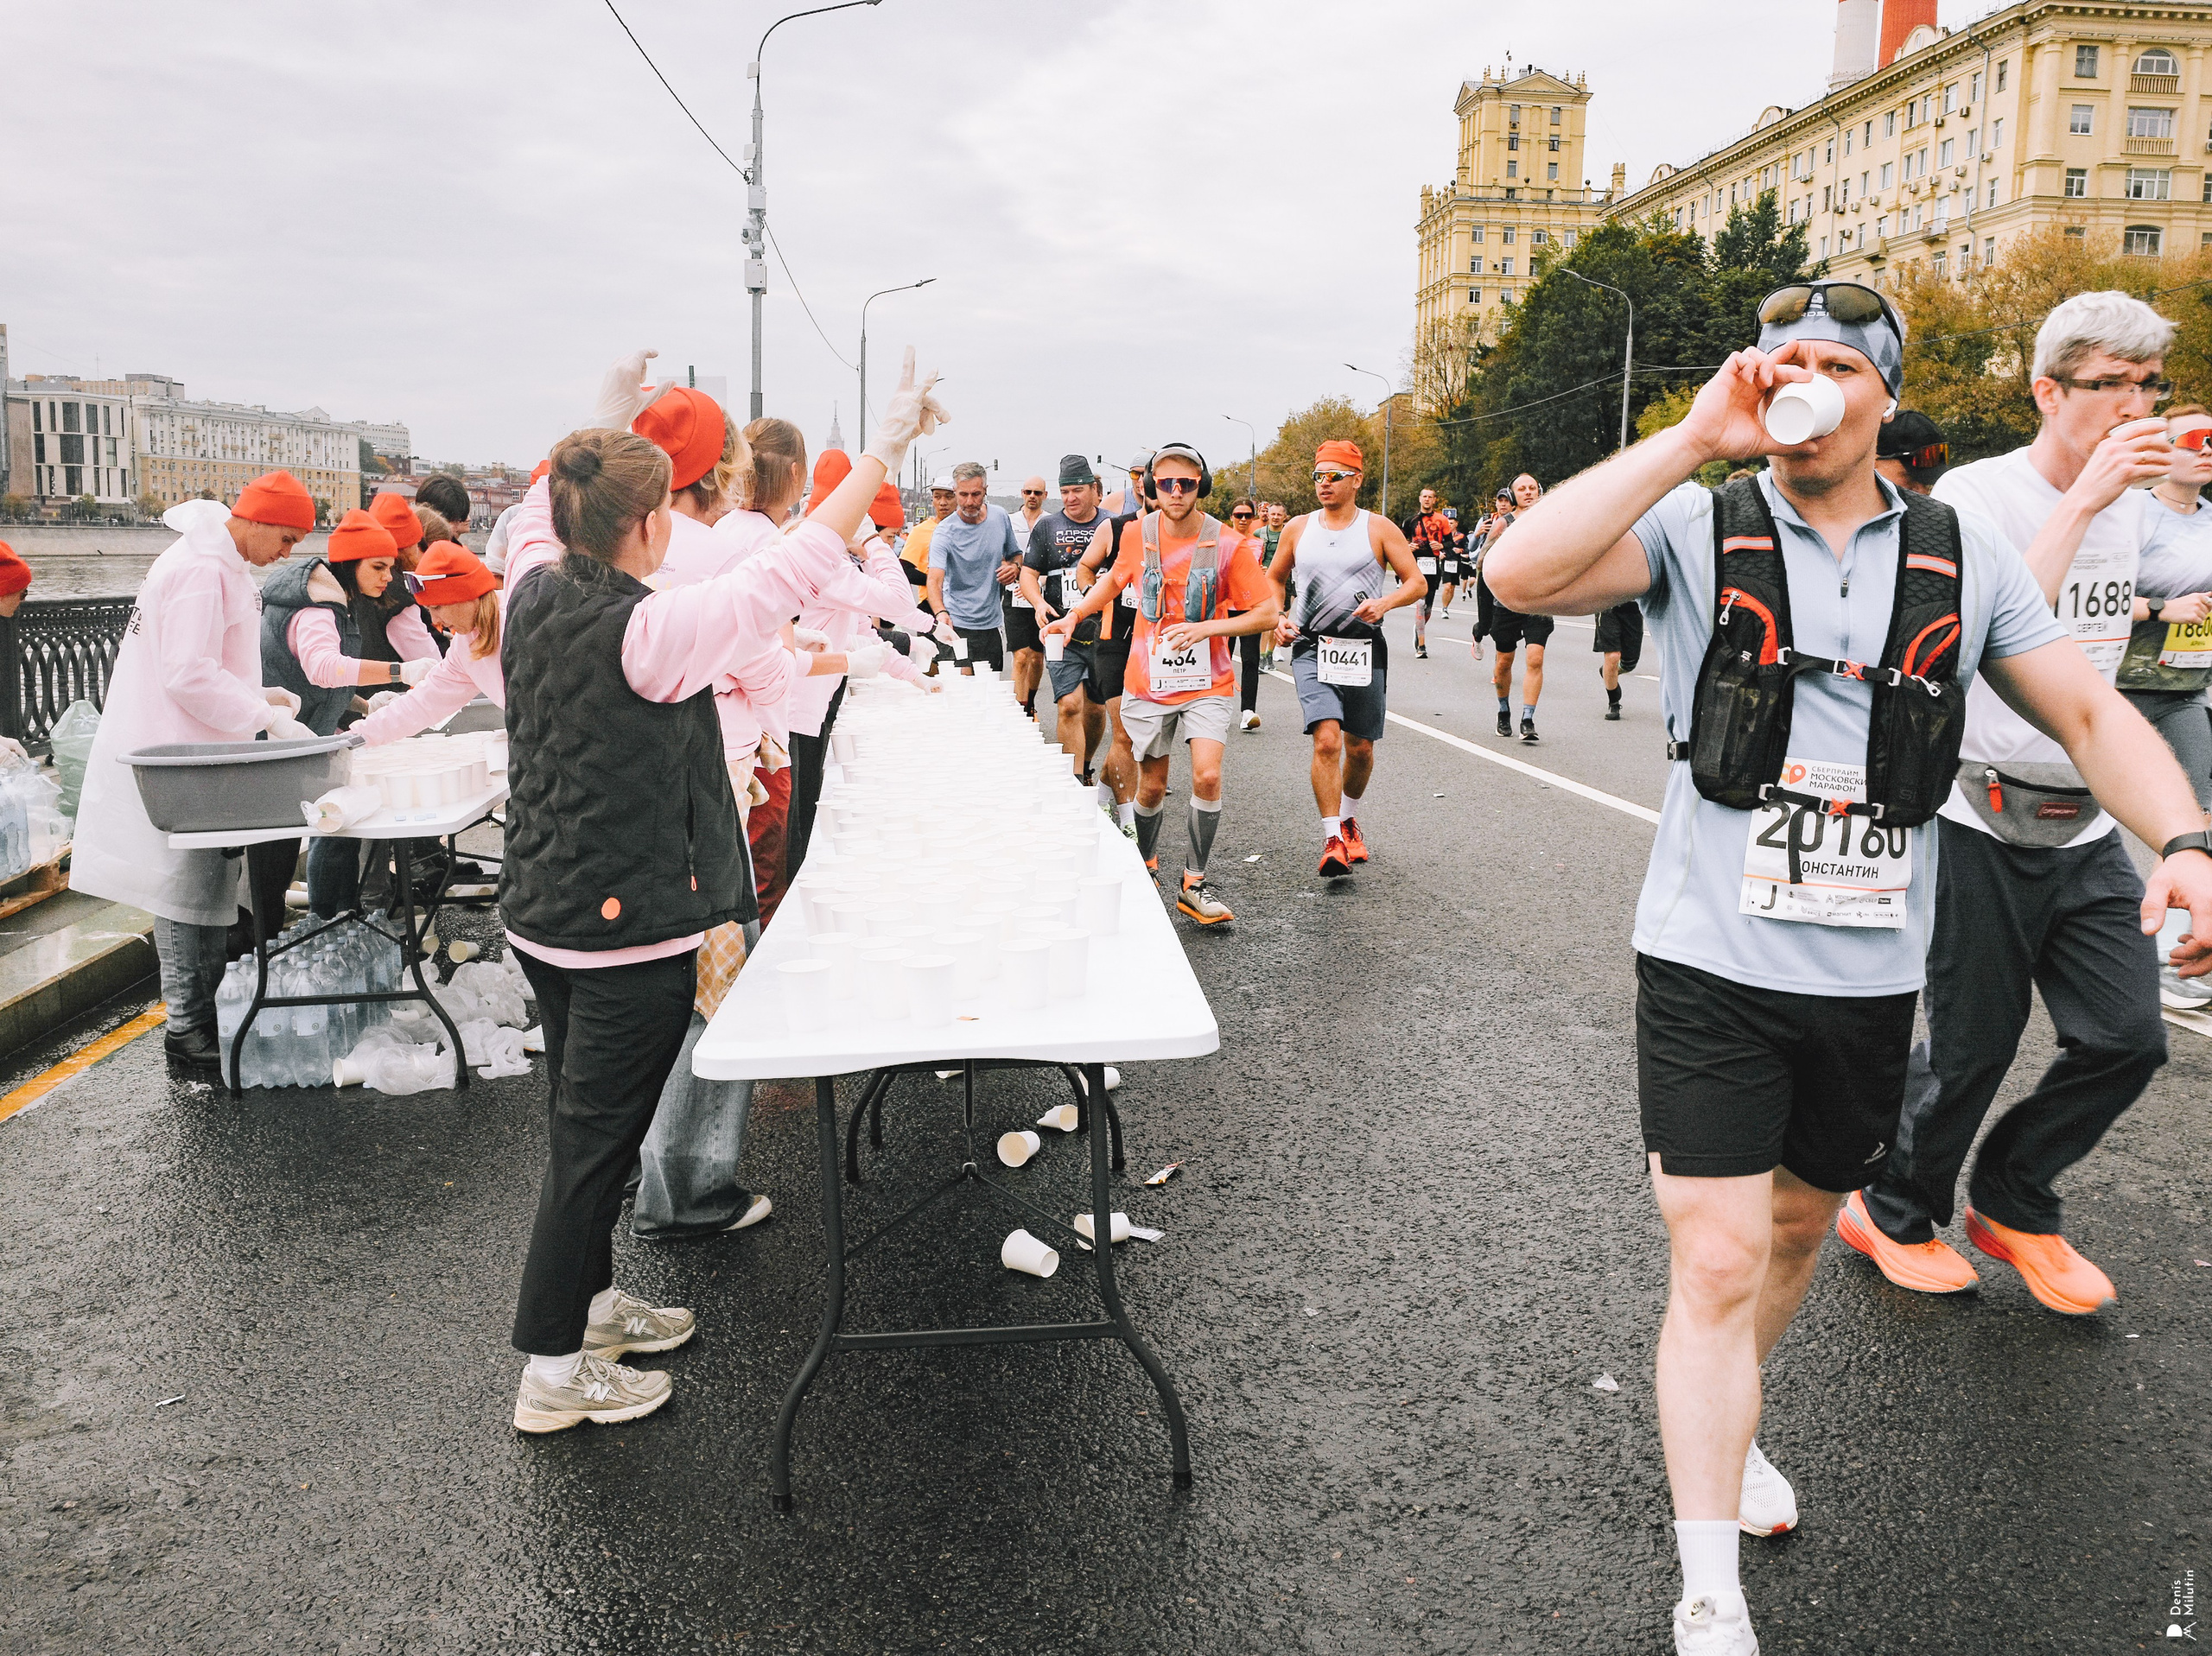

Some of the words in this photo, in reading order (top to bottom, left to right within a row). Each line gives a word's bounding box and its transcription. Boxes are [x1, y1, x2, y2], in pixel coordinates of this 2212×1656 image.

[1064, 579, 1078, 592] 10
[1320, 649, 1367, 666] 10441
[1157, 679, 1162, 689] J
[1810, 772, 1867, 786] МОСКОВСКИ
[1811, 765, 1859, 777] СБЕРПРАЙМ
[1808, 781, 1857, 793] МАРАФОН
[1756, 798, 1907, 860] 20160
[1799, 860, 1879, 879] ОНСТАНТИН
[1760, 885, 1777, 910] J
[623, 1317, 648, 1337] N
[583, 1382, 611, 1404] N
